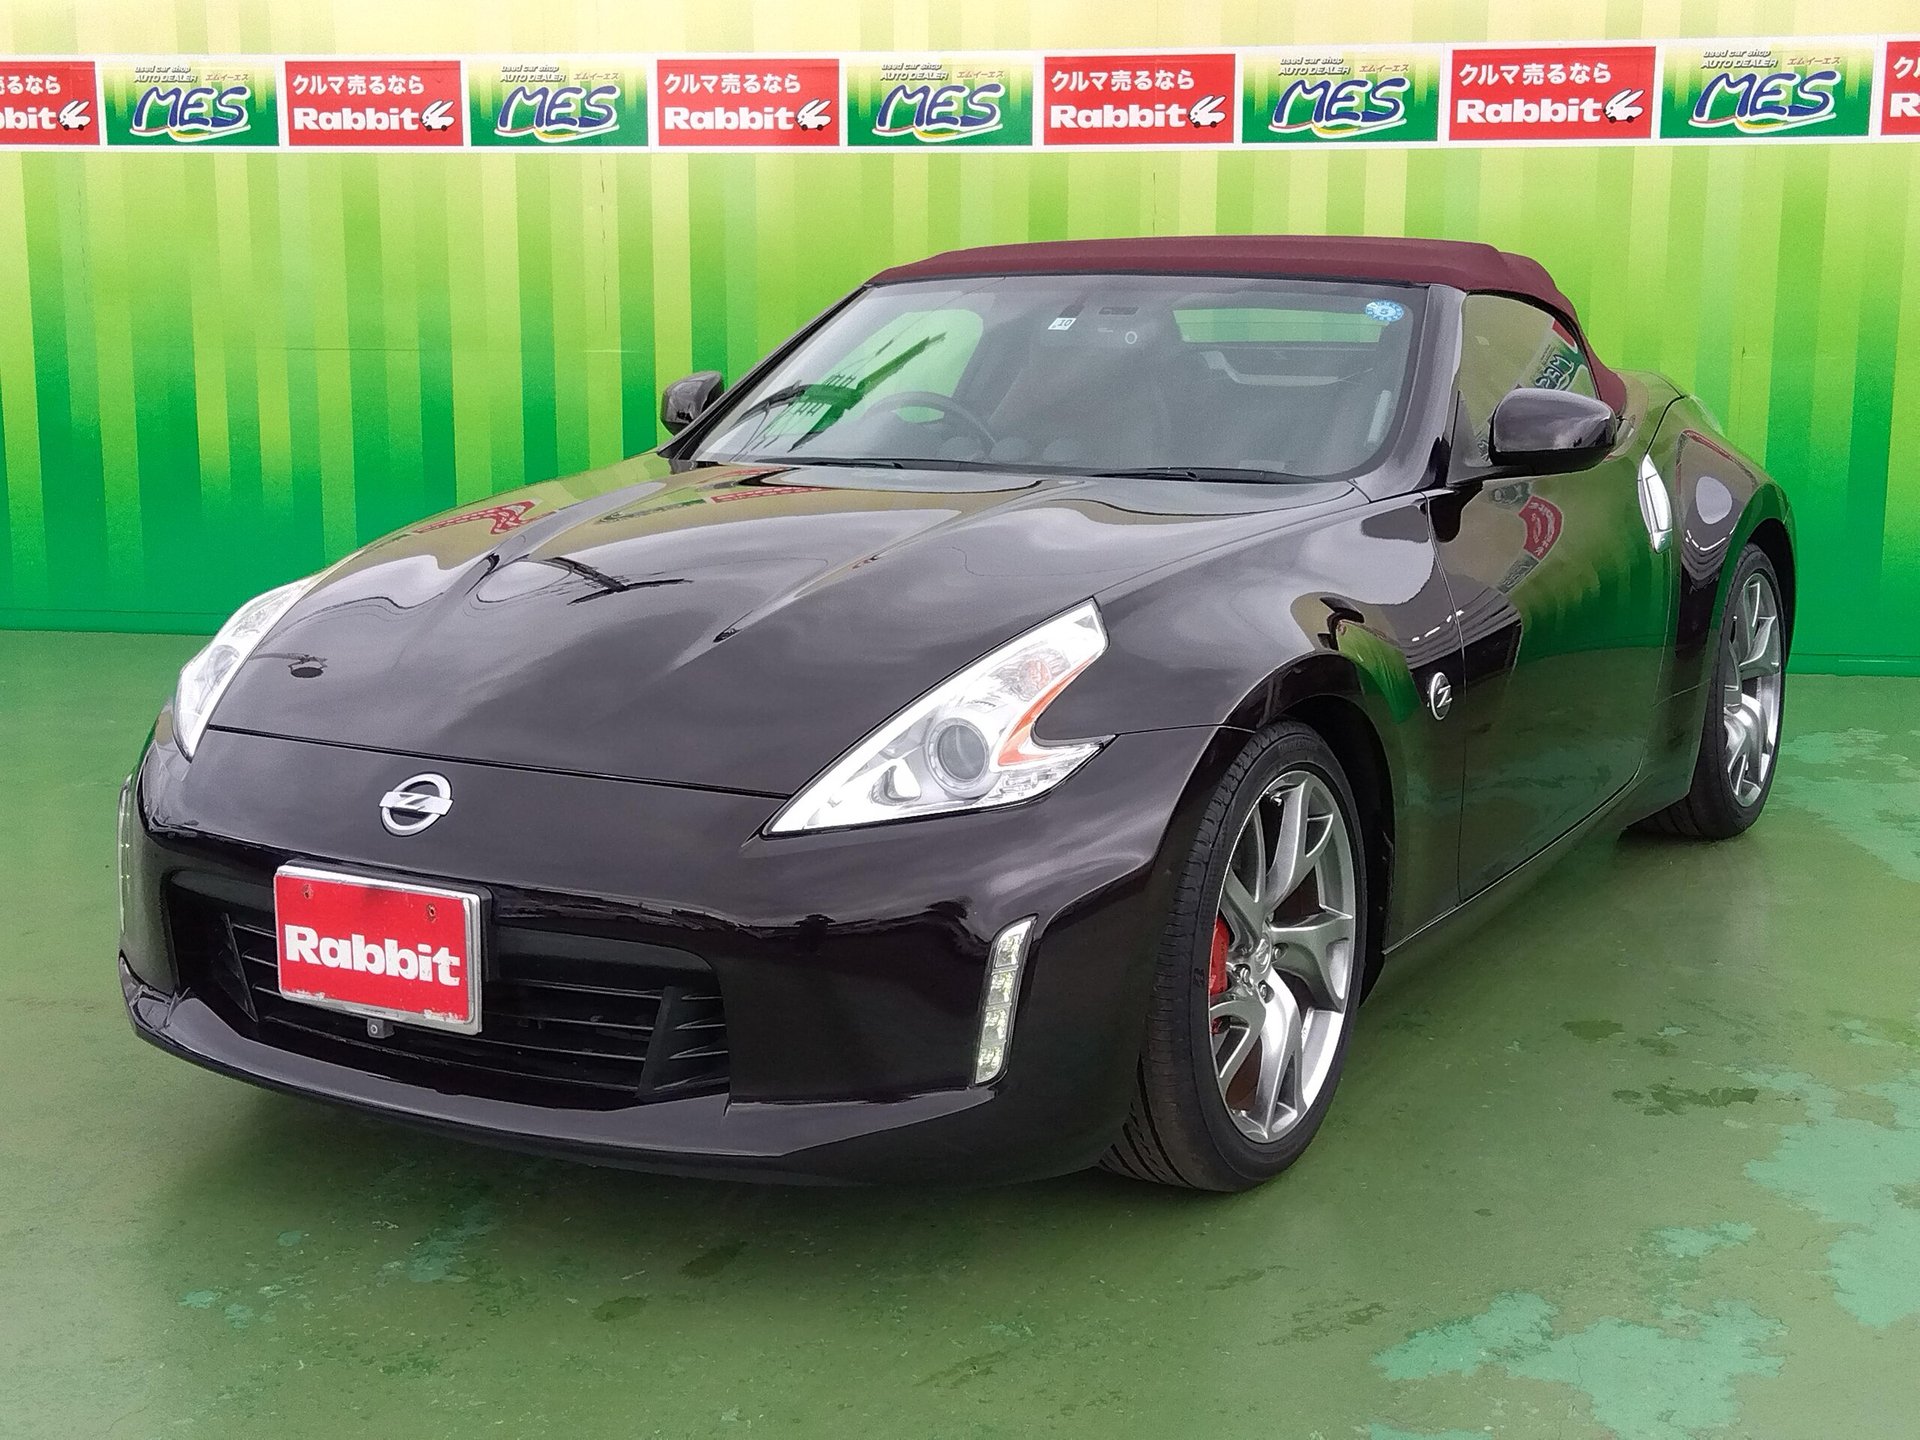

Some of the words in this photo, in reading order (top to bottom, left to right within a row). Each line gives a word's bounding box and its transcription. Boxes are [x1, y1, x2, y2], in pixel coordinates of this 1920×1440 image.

[1280, 57, 1304, 65] used
[1321, 56, 1344, 65] shop
[1703, 49, 1729, 58] used
[1747, 49, 1771, 57] shop
[1787, 56, 1840, 66] エムイーエス
[171, 66, 191, 74] shop
[920, 62, 942, 70] shop
[1278, 66, 1310, 76] AUTO
[1309, 66, 1351, 75] DEALER
[1359, 63, 1409, 73] エムイーエス
[1701, 59, 1733, 69] AUTO
[1733, 59, 1778, 68] DEALER
[134, 75, 160, 83] AUTO
[160, 75, 198, 83] DEALER
[205, 73, 249, 81] エムイーエス
[500, 74, 528, 82] AUTO
[528, 74, 567, 82] DEALER
[573, 72, 619, 81] エムイーエス
[880, 72, 909, 81] AUTO
[909, 72, 949, 81] DEALER
[956, 70, 1004, 79] エムイーエス
[1051, 69, 1195, 92] クルマ売るなら
[1458, 62, 1612, 87] クルマ売るなら
[293, 74, 425, 96] クルマ売るなら
[664, 73, 801, 94] クルマ売るなら
[1272, 77, 1410, 127] MES
[1693, 70, 1841, 122] MES
[132, 86, 251, 131] MES
[498, 85, 620, 131] MES
[876, 83, 1005, 131] MES
[1456, 97, 1603, 124] Rabbit
[0, 107, 57, 130] bit
[293, 107, 420, 131] Rabbit
[664, 106, 795, 130] Rabbit
[1050, 103, 1187, 129] Rabbit
[1057, 319, 1073, 327] 10
[285, 924, 460, 987] Rabbit
